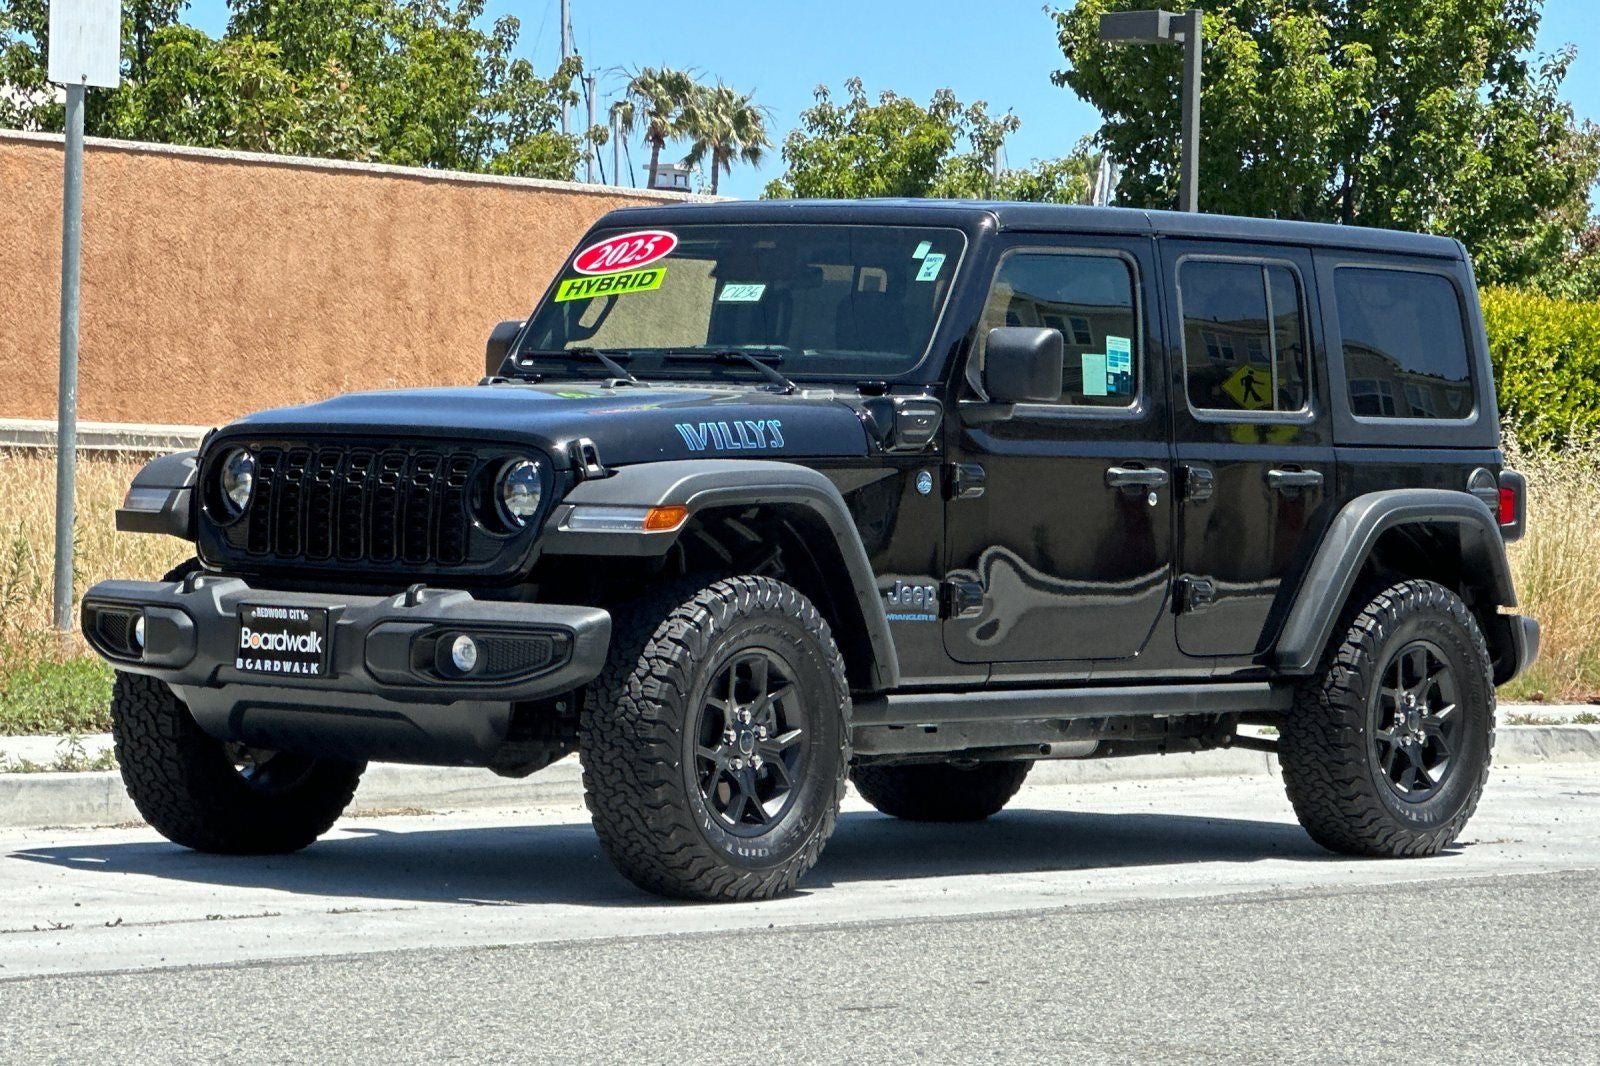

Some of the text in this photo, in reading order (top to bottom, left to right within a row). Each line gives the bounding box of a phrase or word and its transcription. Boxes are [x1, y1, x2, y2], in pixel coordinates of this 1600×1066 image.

[586, 235, 664, 271] 2025
[564, 271, 659, 297] HYBRID
[674, 419, 785, 451] WILLYS
[887, 580, 936, 610] Jeep
[256, 607, 305, 620] REDWOOD CITY
[240, 626, 322, 653] Boardwalk
[235, 657, 320, 675] BOARDWALK
